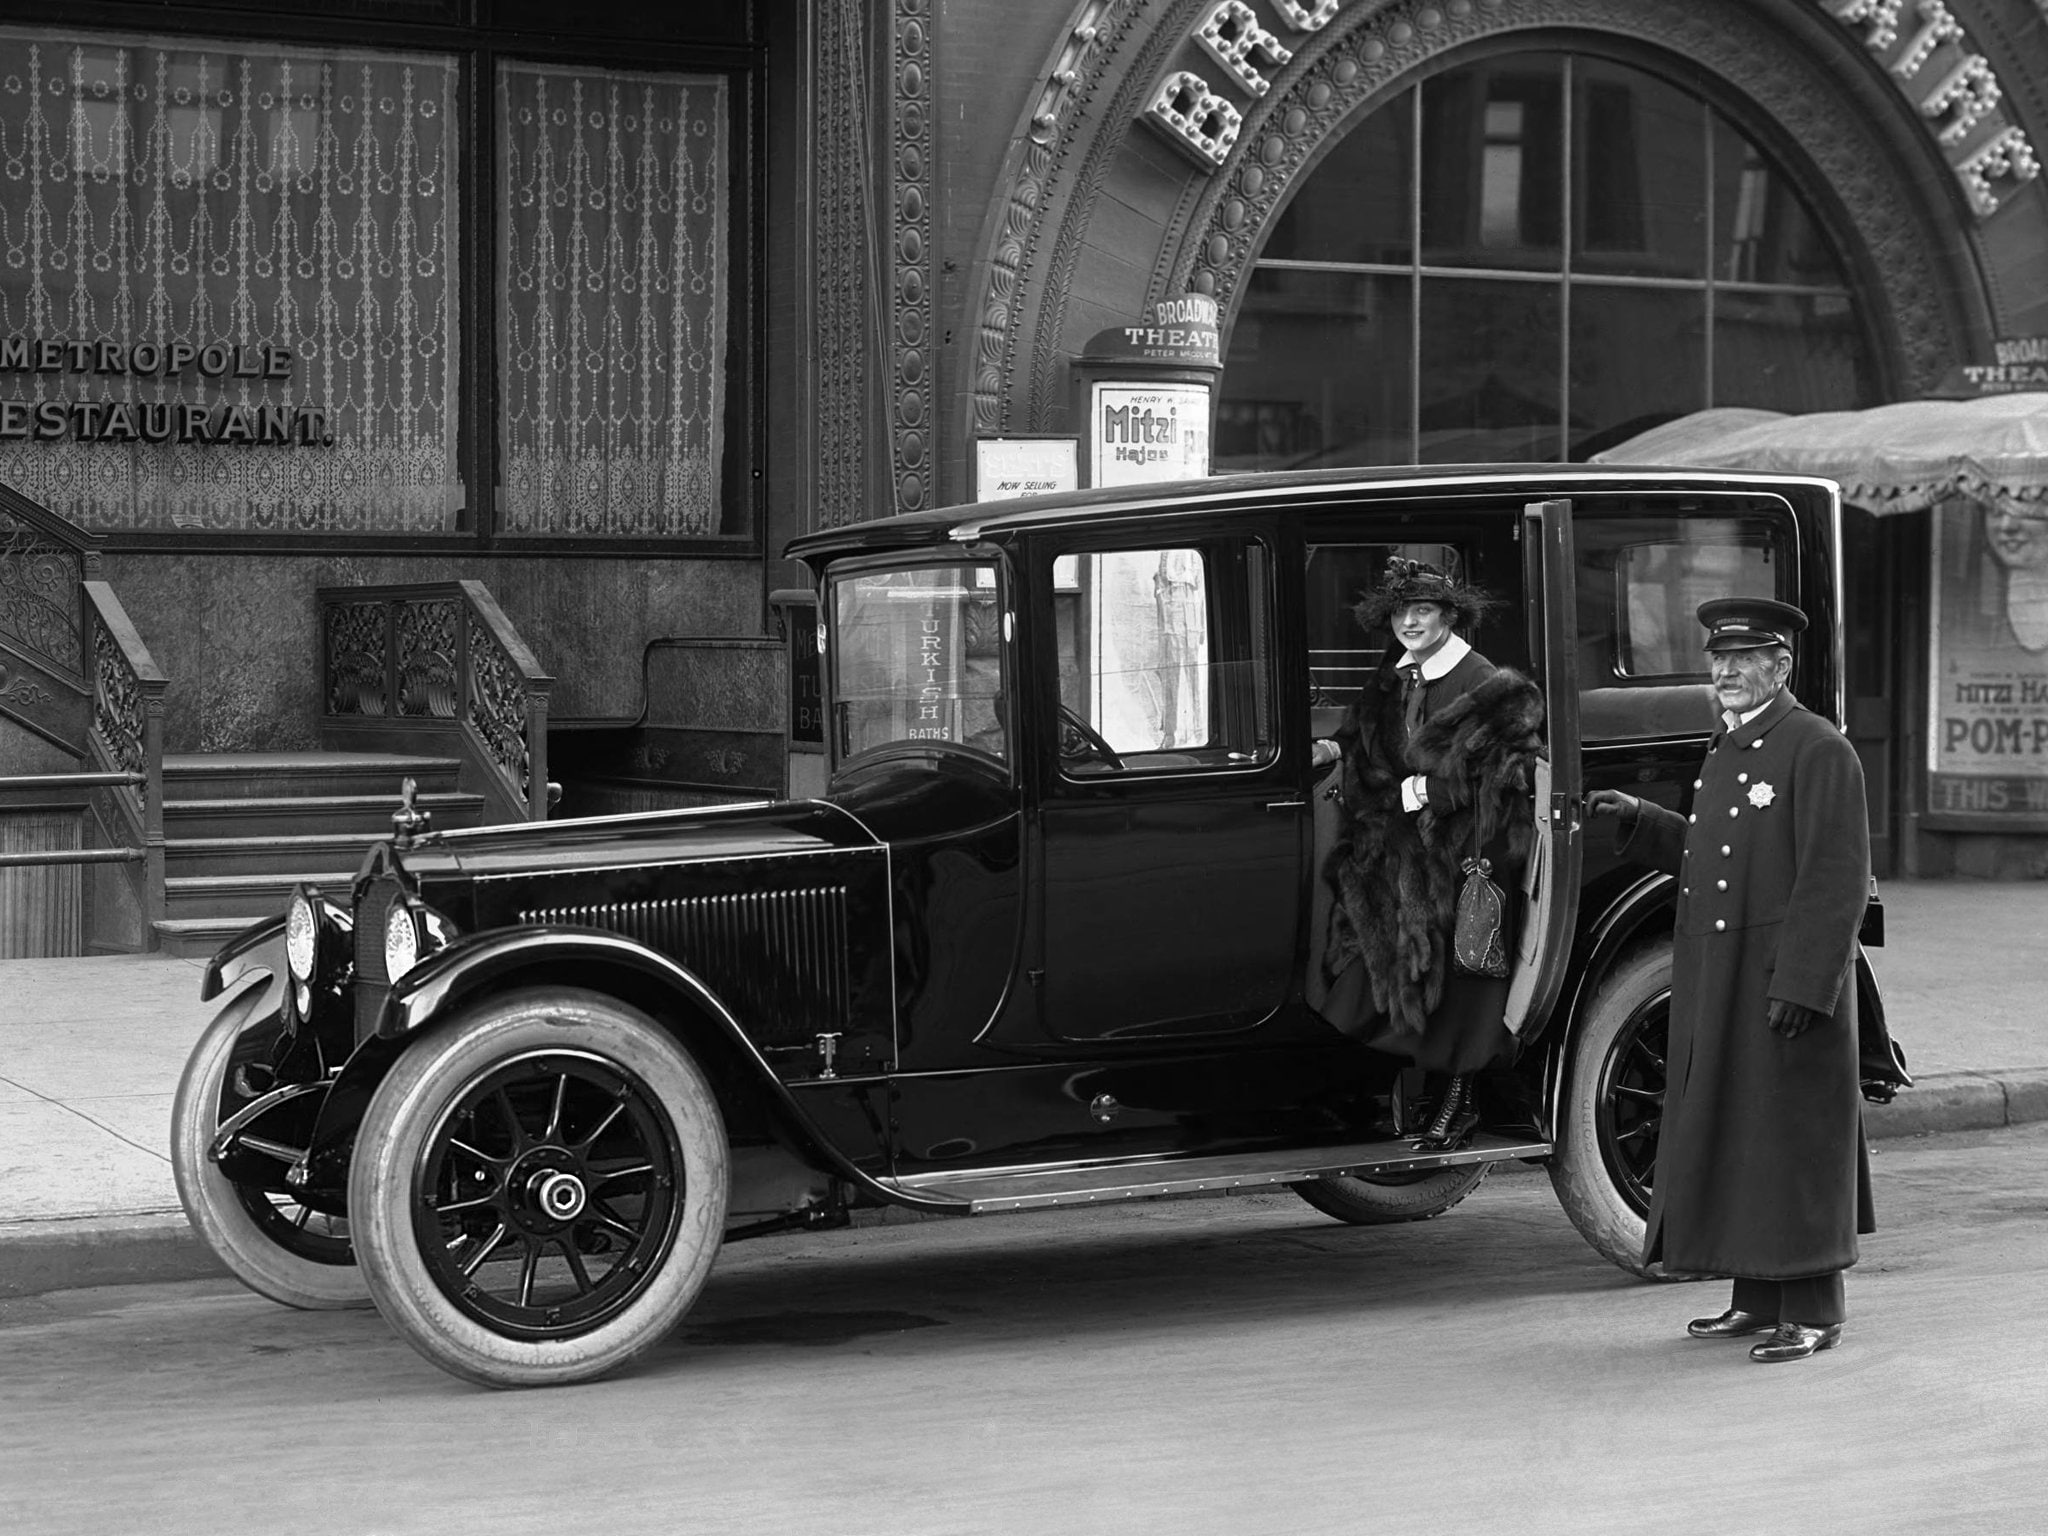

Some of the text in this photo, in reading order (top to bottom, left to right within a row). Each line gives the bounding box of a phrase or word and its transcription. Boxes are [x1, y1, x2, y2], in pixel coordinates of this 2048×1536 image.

[0, 338, 293, 377] METROPOLE
[1130, 396, 1162, 404] HENRY
[1105, 404, 1177, 444] Mitzi
[997, 481, 1057, 491] NOW SELLING
[1941, 778, 2010, 811] THIS
